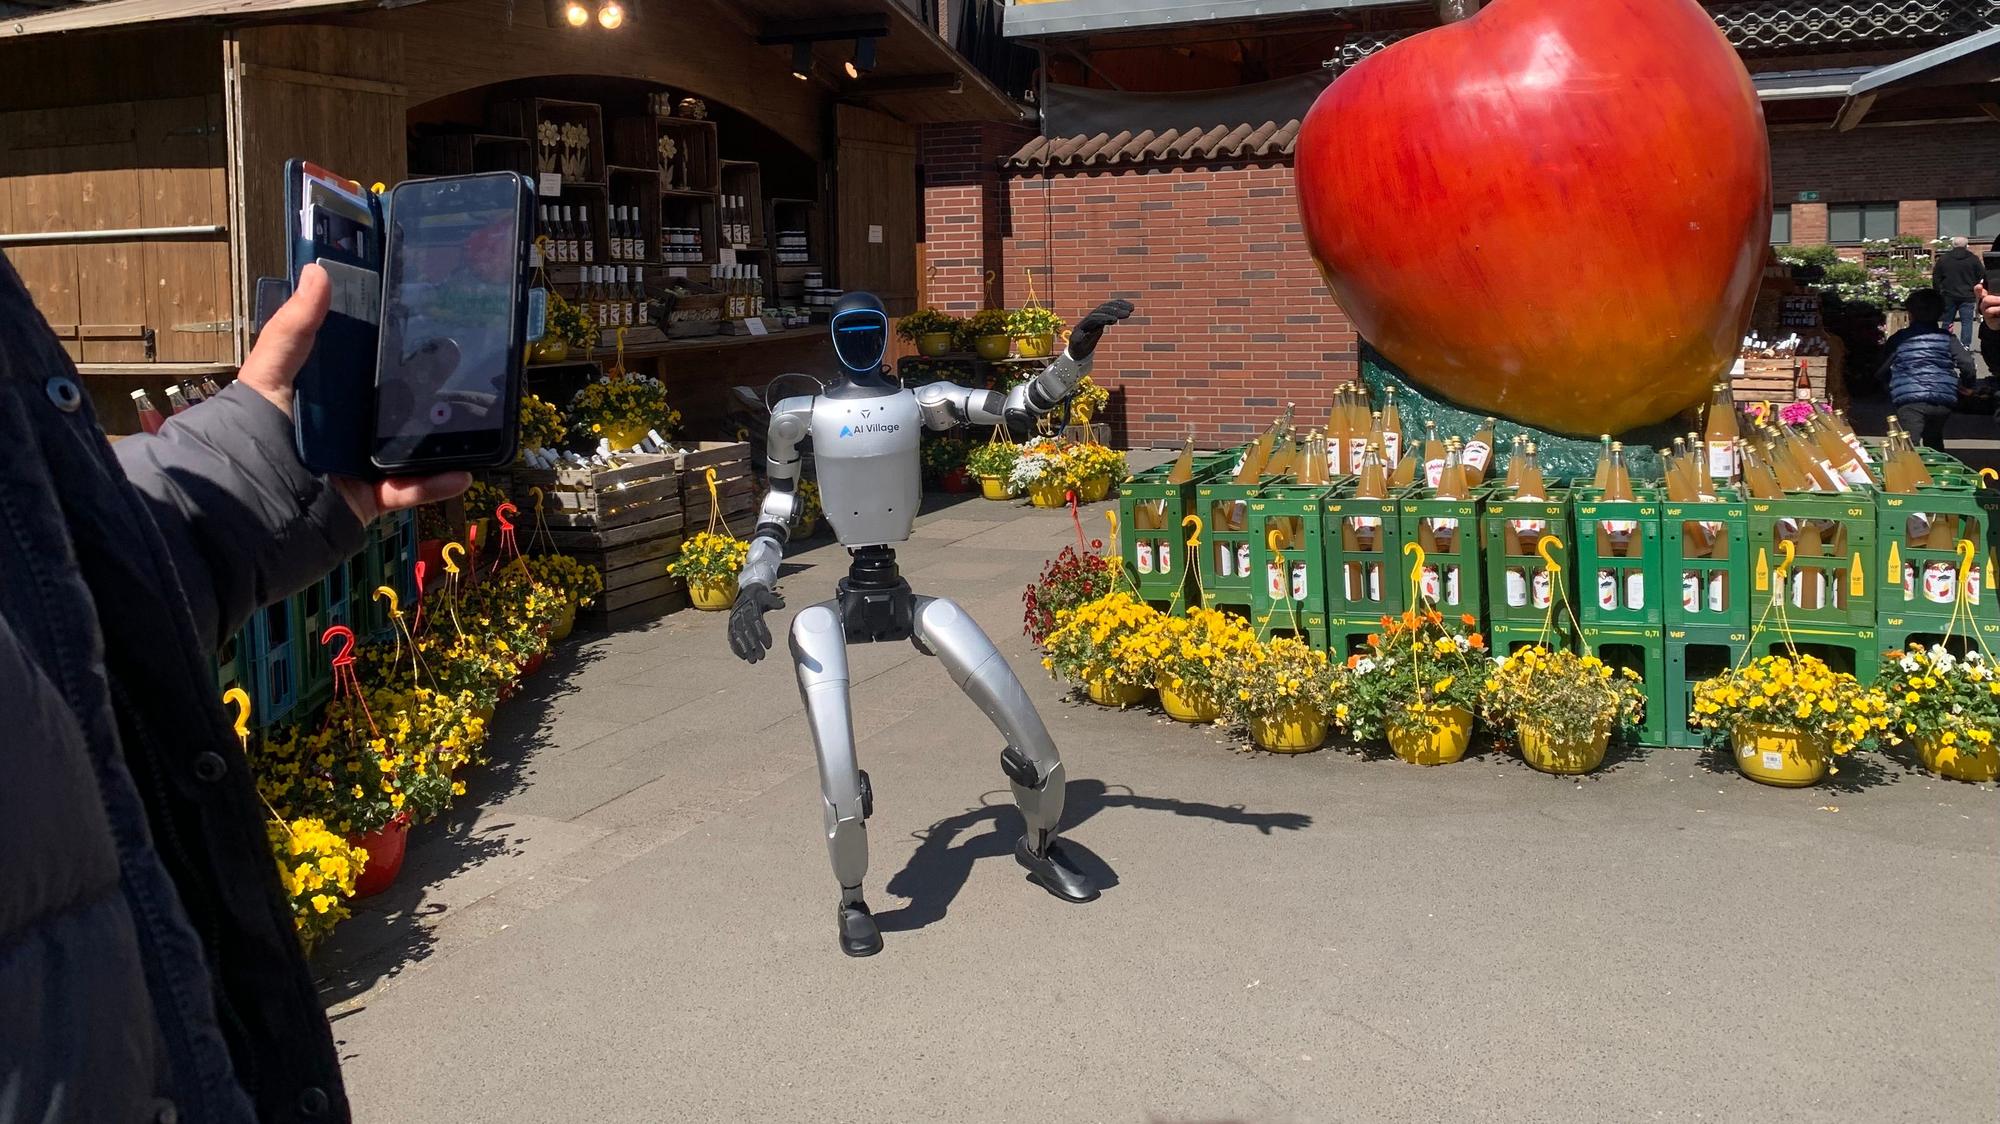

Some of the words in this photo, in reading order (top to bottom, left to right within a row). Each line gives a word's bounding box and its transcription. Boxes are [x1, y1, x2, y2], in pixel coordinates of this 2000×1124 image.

[854, 425, 864, 434] AI
[866, 423, 900, 434] Village
[1251, 503, 1266, 511] VdF
[1887, 499, 1904, 507] VdF
[1328, 504, 1342, 512] VdF
[1404, 505, 1418, 513] VdF
[1488, 506, 1504, 514] VdF
[1667, 508, 1682, 516] VdF
[1753, 504, 1769, 512] VdF
[1887, 618, 1905, 626] VdF
[1669, 631, 1686, 639] VdF
